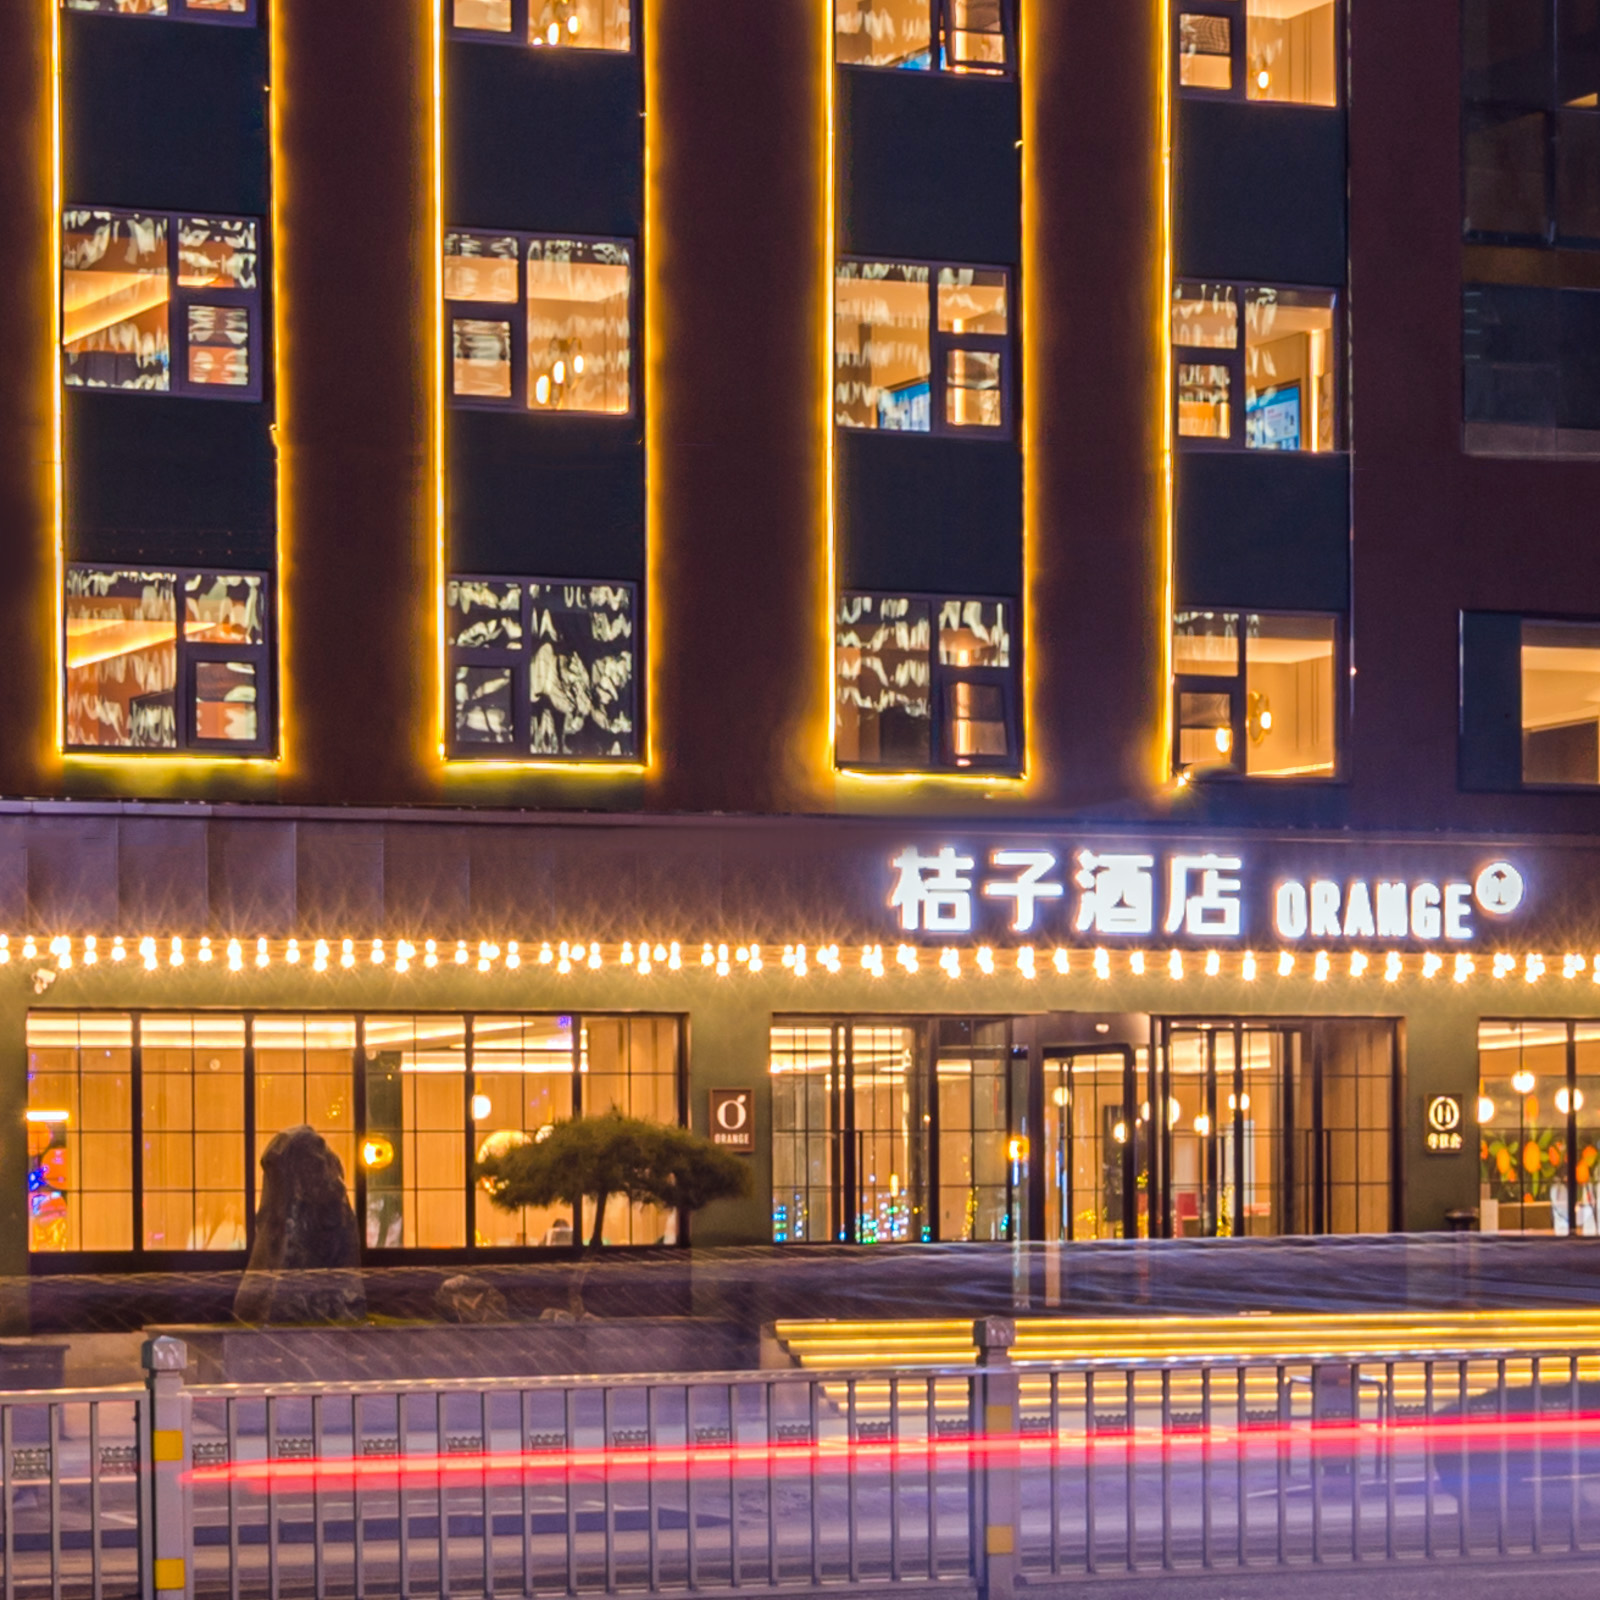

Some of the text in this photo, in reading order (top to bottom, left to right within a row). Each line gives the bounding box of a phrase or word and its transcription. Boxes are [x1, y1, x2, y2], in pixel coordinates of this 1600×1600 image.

[889, 846, 1473, 940] 桔子酒店 ORANGE
[714, 1133, 749, 1145] ORANGE
